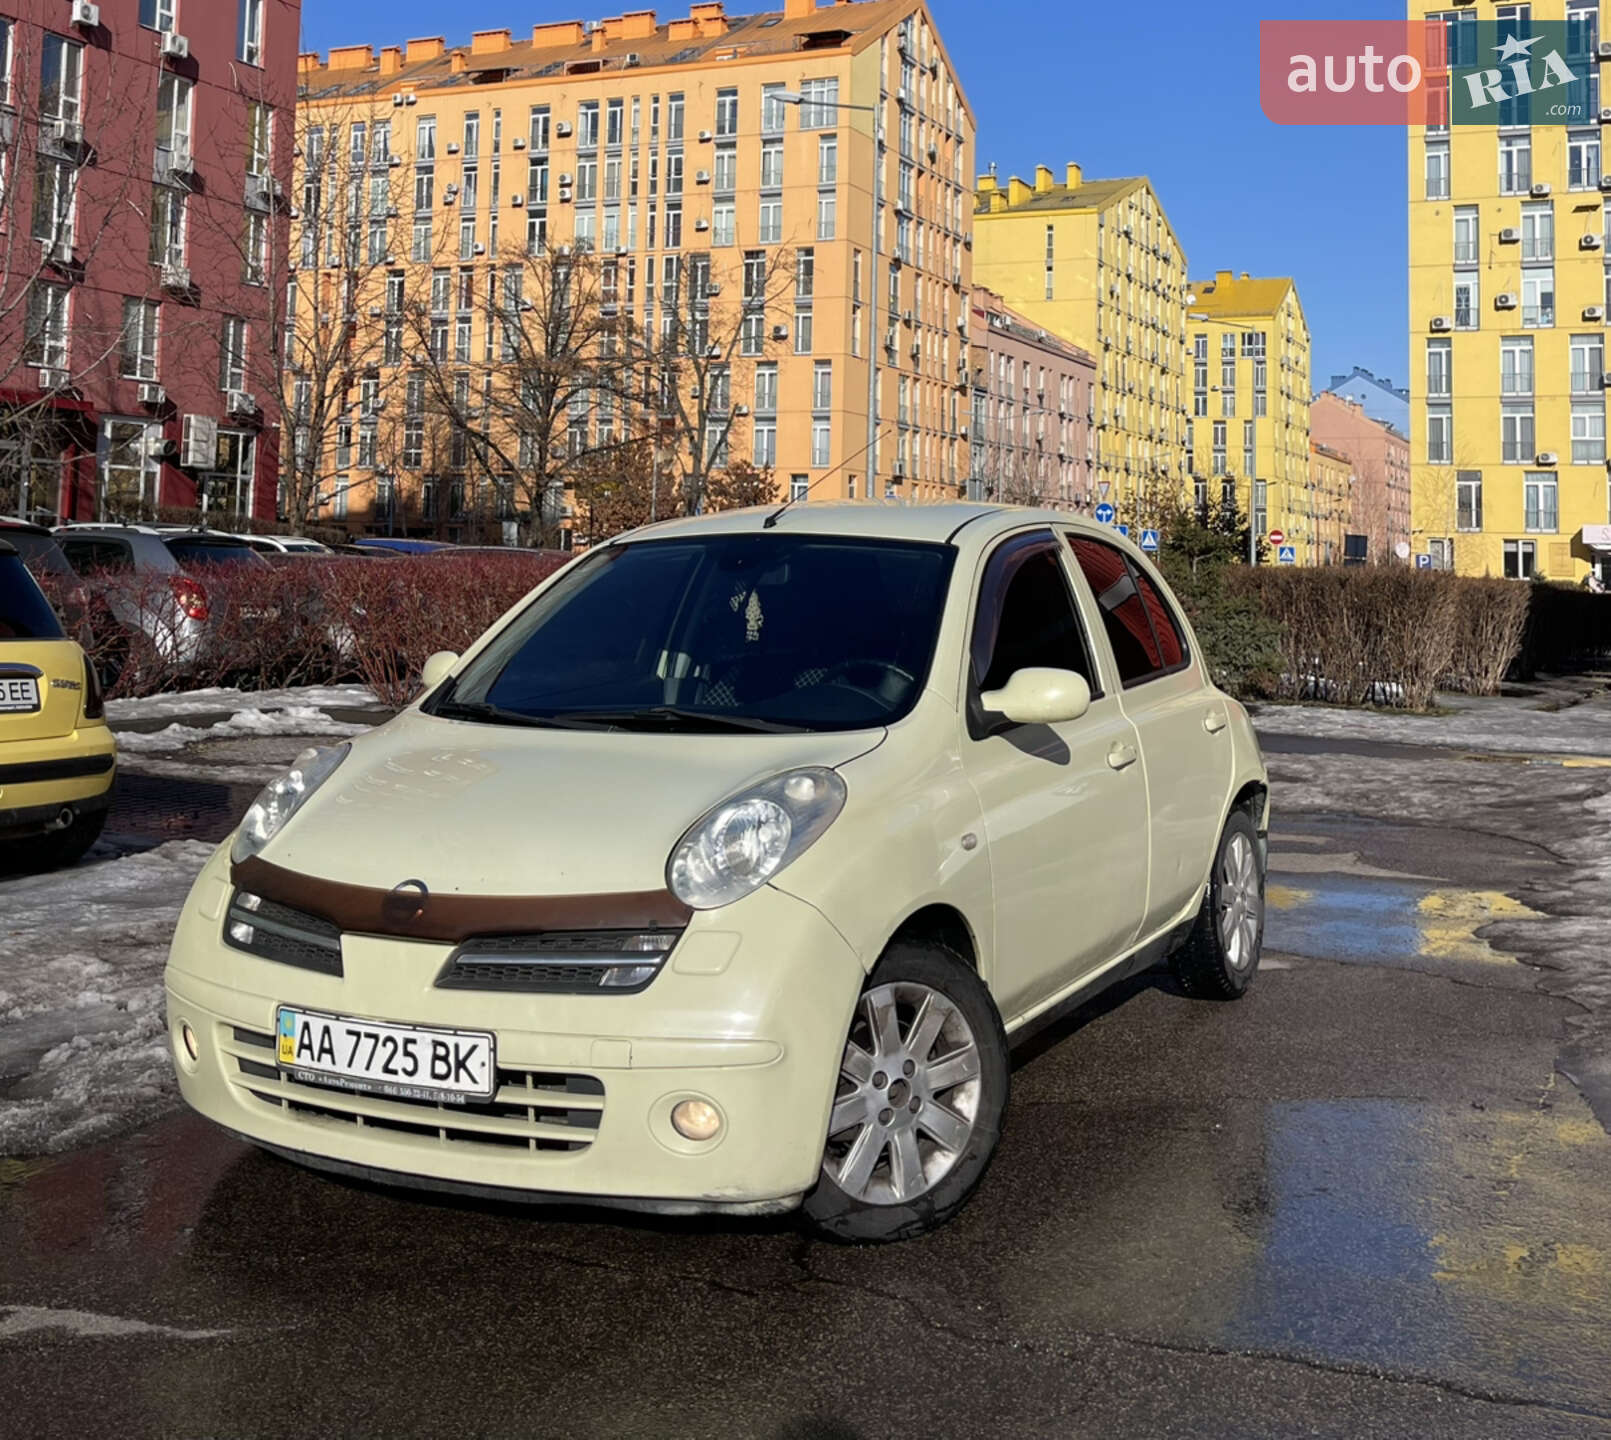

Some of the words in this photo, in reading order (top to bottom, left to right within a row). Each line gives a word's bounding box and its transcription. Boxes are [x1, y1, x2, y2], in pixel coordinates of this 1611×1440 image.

[1419, 555, 1429, 568] P
[8, 682, 32, 701] EE
[281, 1044, 294, 1057] UA
[296, 1020, 336, 1066] AA
[345, 1028, 419, 1078] 7725
[430, 1039, 480, 1085] BK
